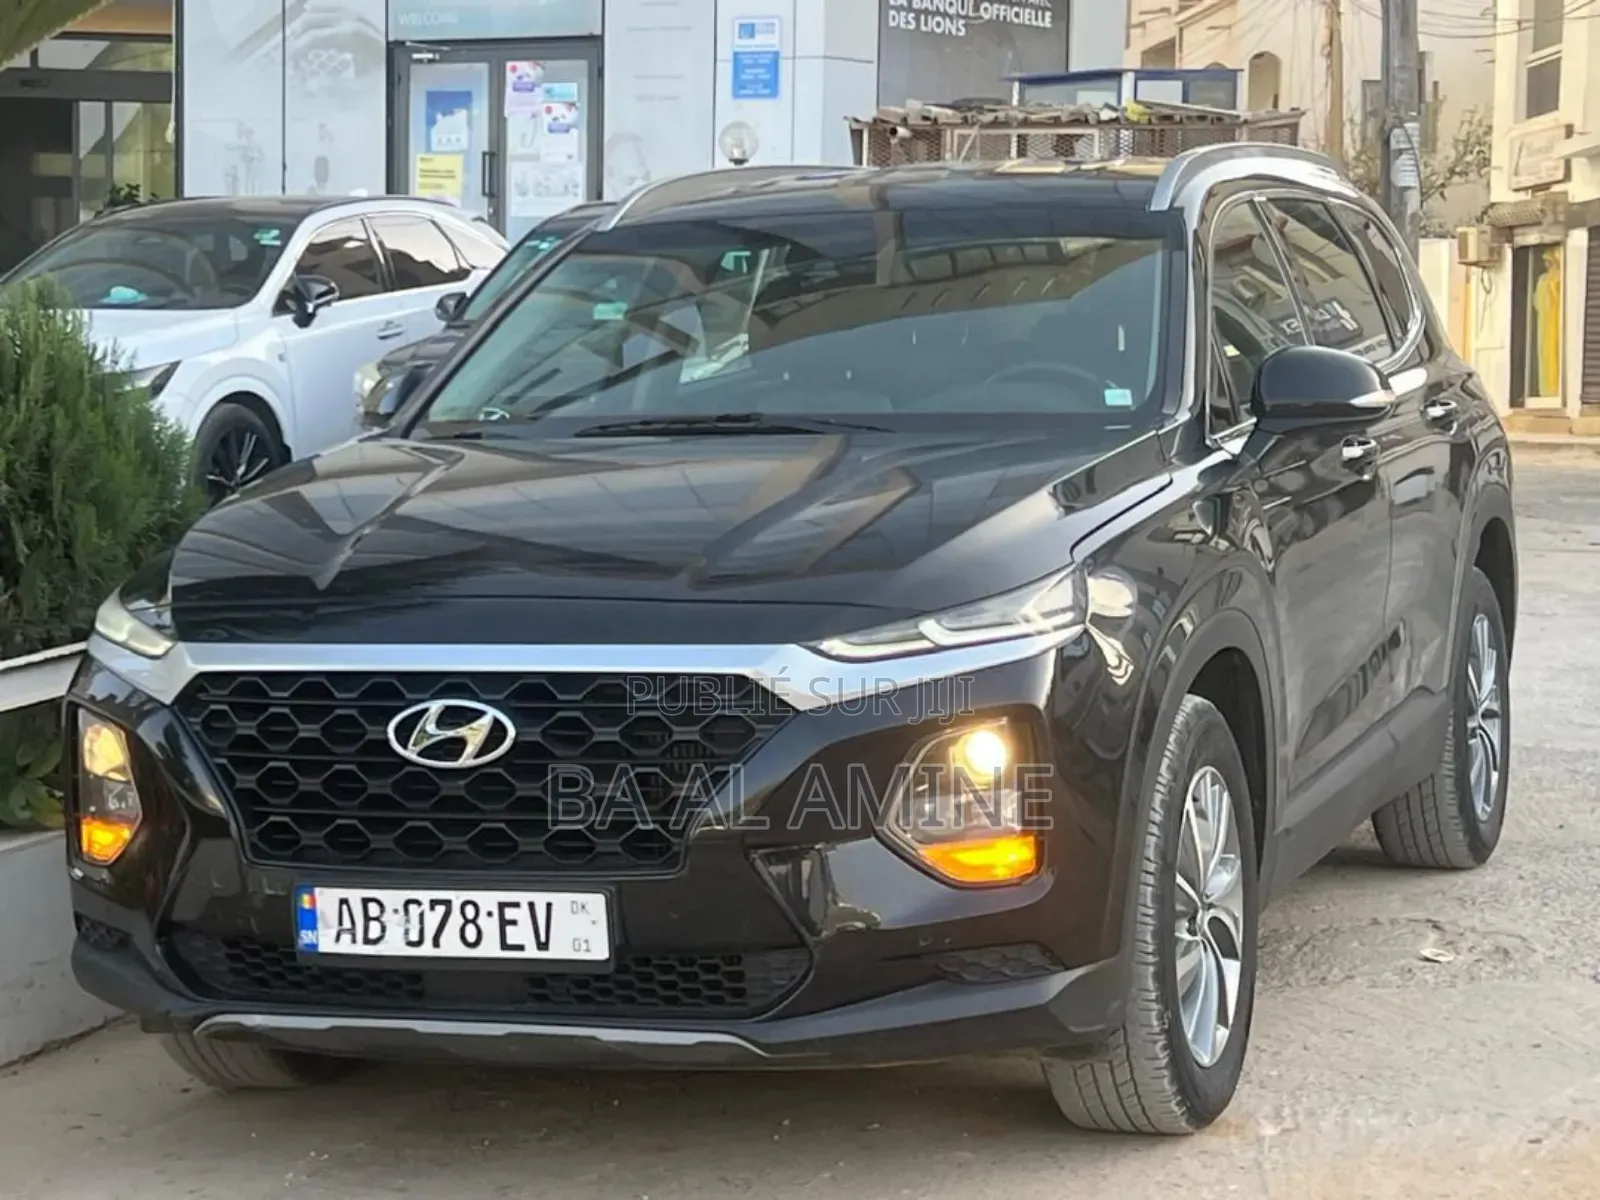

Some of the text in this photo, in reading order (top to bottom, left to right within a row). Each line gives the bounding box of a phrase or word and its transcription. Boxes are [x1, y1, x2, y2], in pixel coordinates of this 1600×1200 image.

[399, 12, 459, 25] WELCO
[888, 10, 967, 37] DES LIONS
[980, 2, 1053, 28] OFFICIELLE
[300, 929, 318, 945] SN
